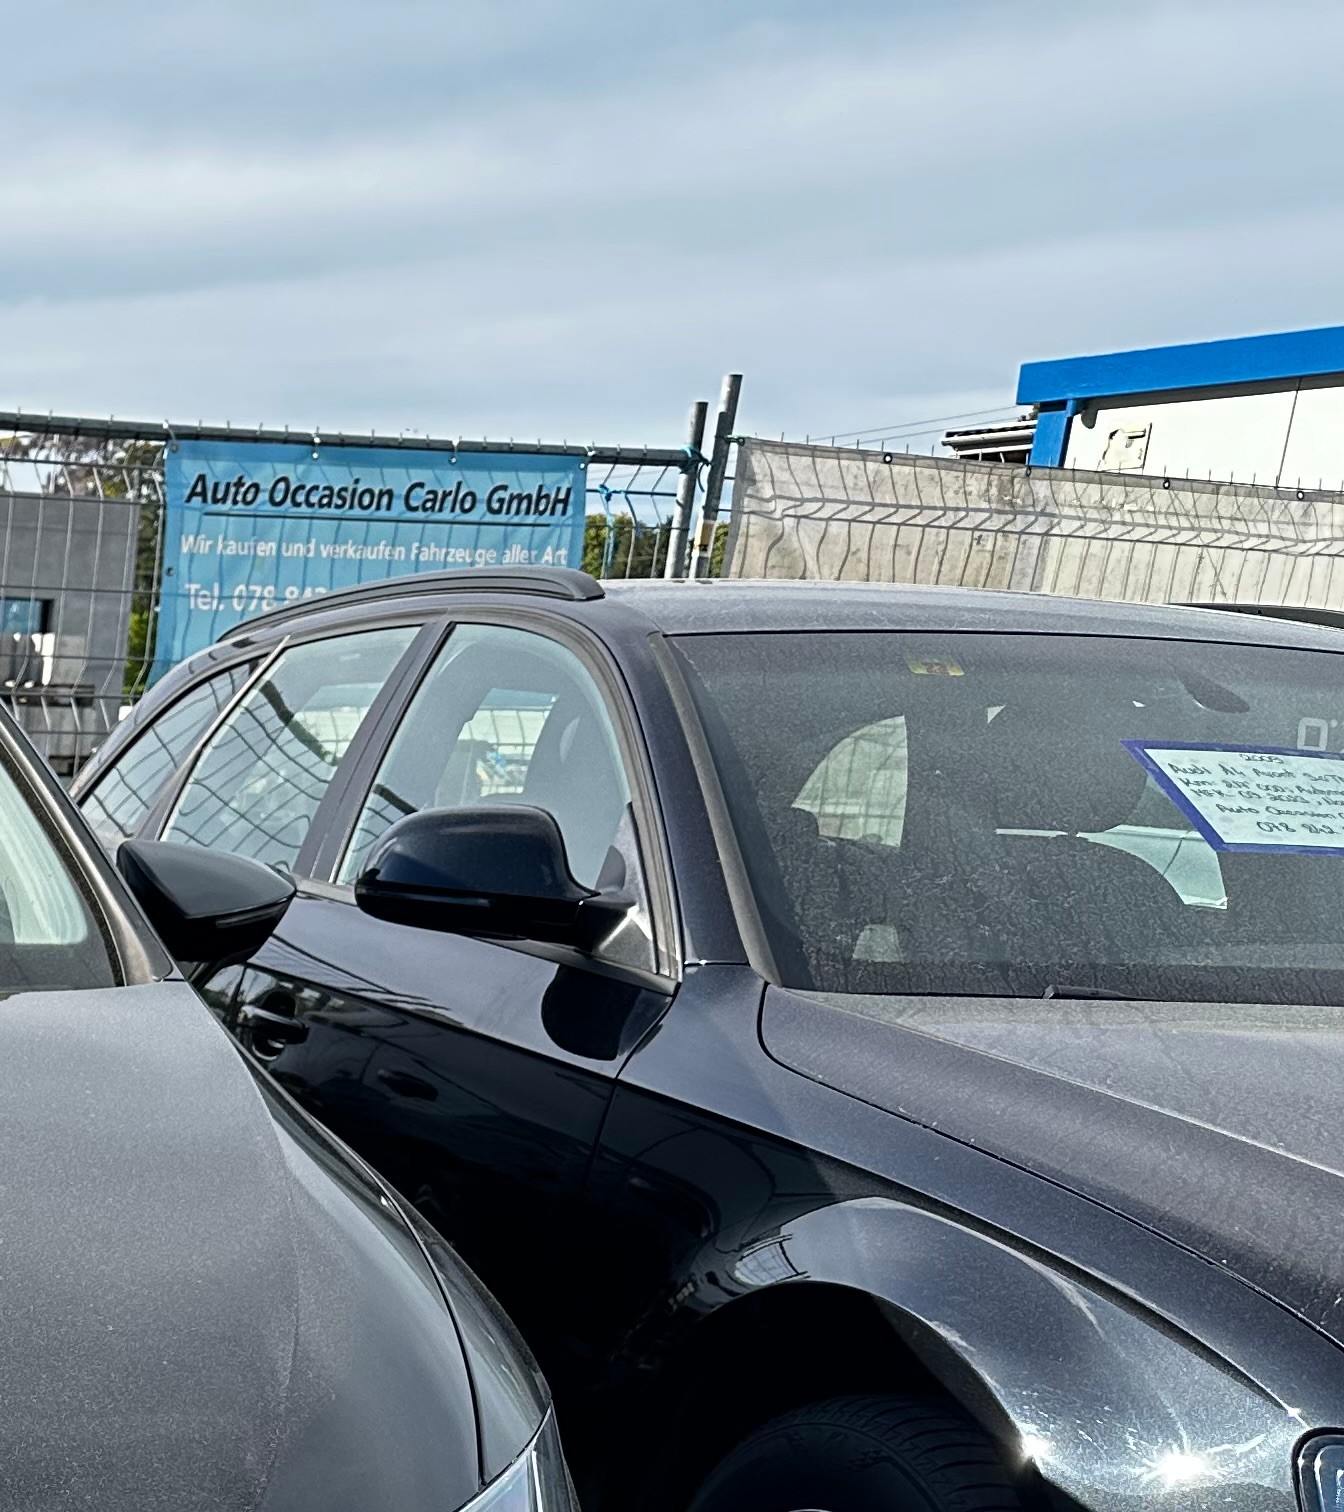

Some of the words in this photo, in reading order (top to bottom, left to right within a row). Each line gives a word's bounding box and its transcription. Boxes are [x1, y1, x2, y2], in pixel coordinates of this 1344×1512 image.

[184, 474, 261, 506] Auto
[268, 476, 394, 511] Occasion
[404, 481, 477, 514] Carlo
[486, 484, 572, 517] GmbH
[181, 535, 212, 555] Wir
[217, 535, 276, 558] kaufen
[282, 538, 316, 557] und
[320, 540, 405, 561] verkaufen
[411, 542, 496, 568] Fahrzeuge
[502, 544, 536, 564] aller
[541, 545, 568, 566] Art
[184, 582, 224, 611] Tel.
[232, 584, 276, 612] 078
